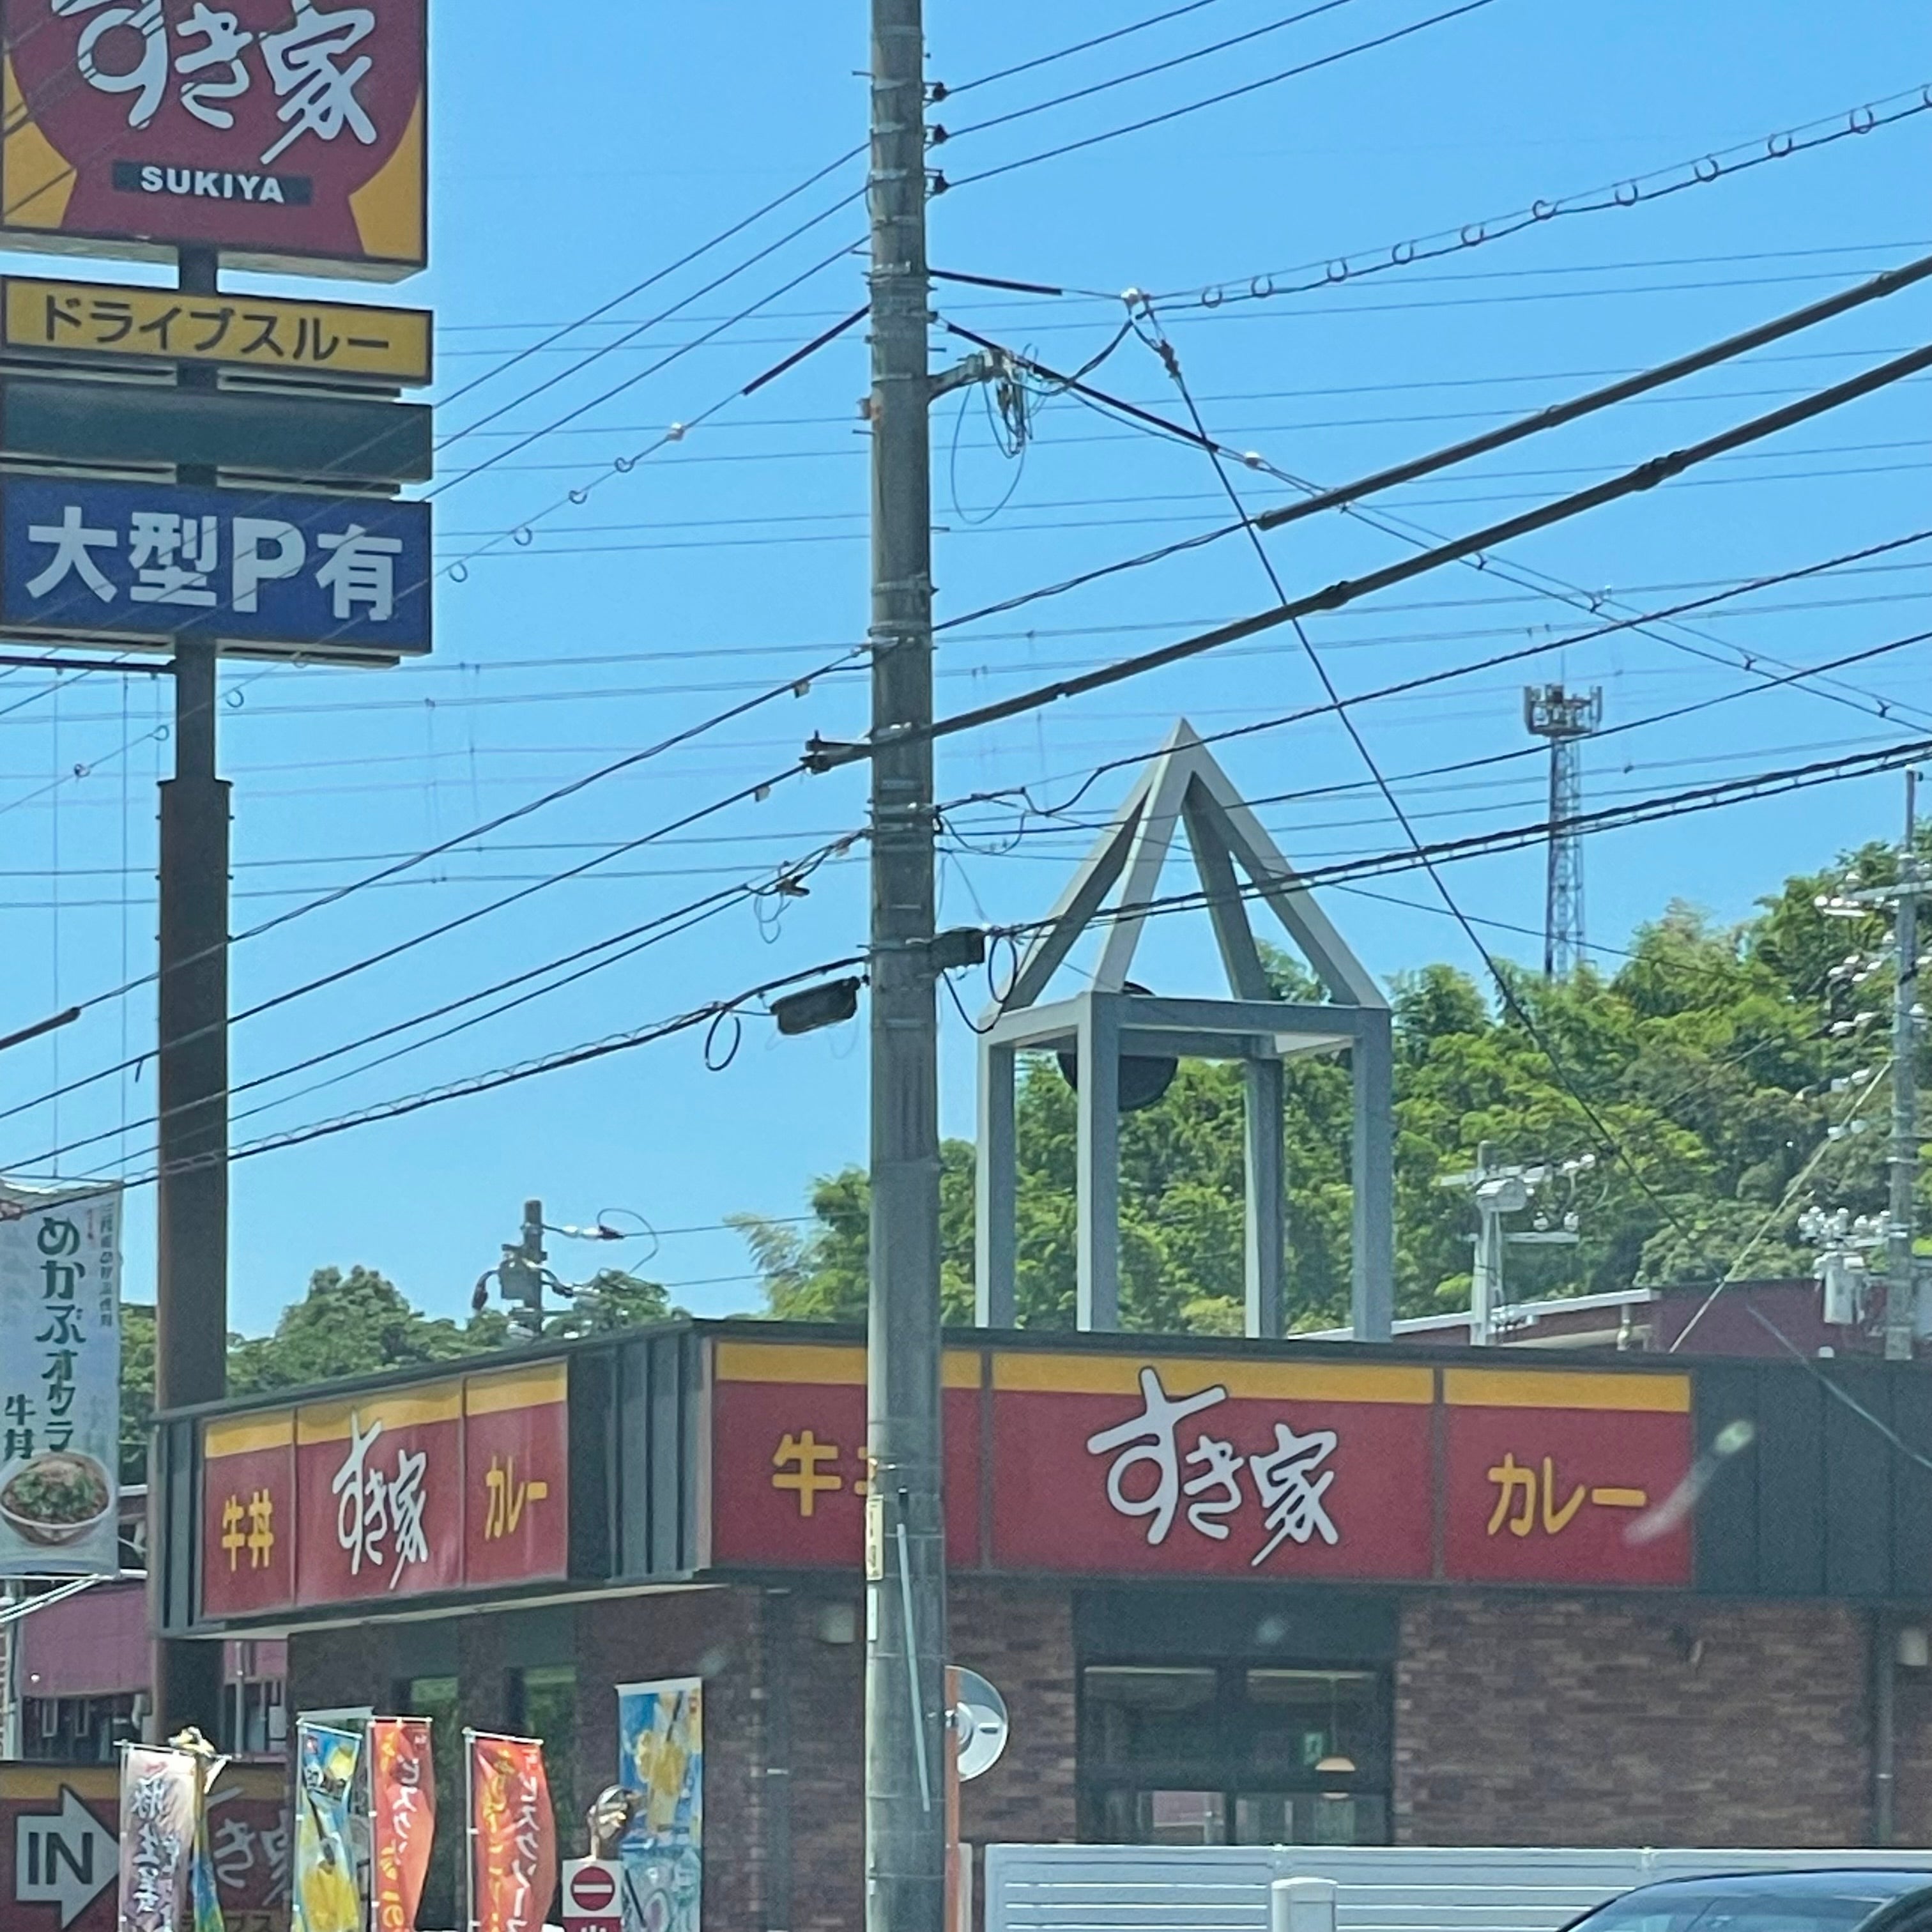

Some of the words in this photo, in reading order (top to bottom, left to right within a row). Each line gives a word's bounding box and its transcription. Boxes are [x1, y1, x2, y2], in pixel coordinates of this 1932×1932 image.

[141, 166, 285, 203] SUKIYA
[45, 295, 390, 362] ドライブスルー
[25, 505, 403, 622] 大型P有
[35, 1216, 86, 1452] めかぶオクラ
[4, 1393, 36, 1462] 牛丼
[1087, 1366, 1339, 1567] すき家
[332, 1411, 429, 1590] すき家
[484, 1455, 548, 1542] カレー
[772, 1430, 868, 1517] 牛
[1487, 1452, 1647, 1537] カレー
[220, 1488, 274, 1572] 牛丼
[28, 1832, 93, 1885] IN
